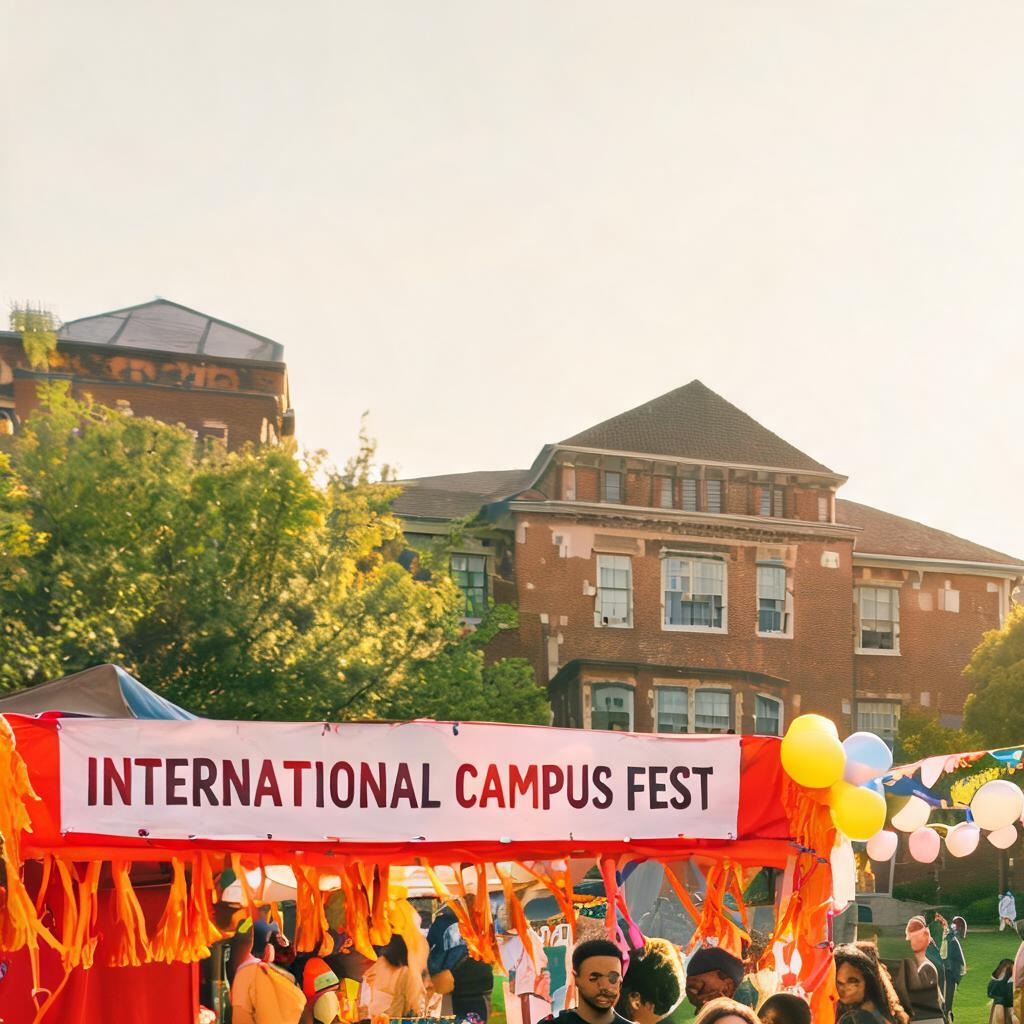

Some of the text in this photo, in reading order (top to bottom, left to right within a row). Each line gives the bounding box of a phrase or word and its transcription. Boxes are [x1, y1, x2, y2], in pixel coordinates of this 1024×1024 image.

[88, 757, 713, 811] INTERNATIONAL CAMPUS FEST
